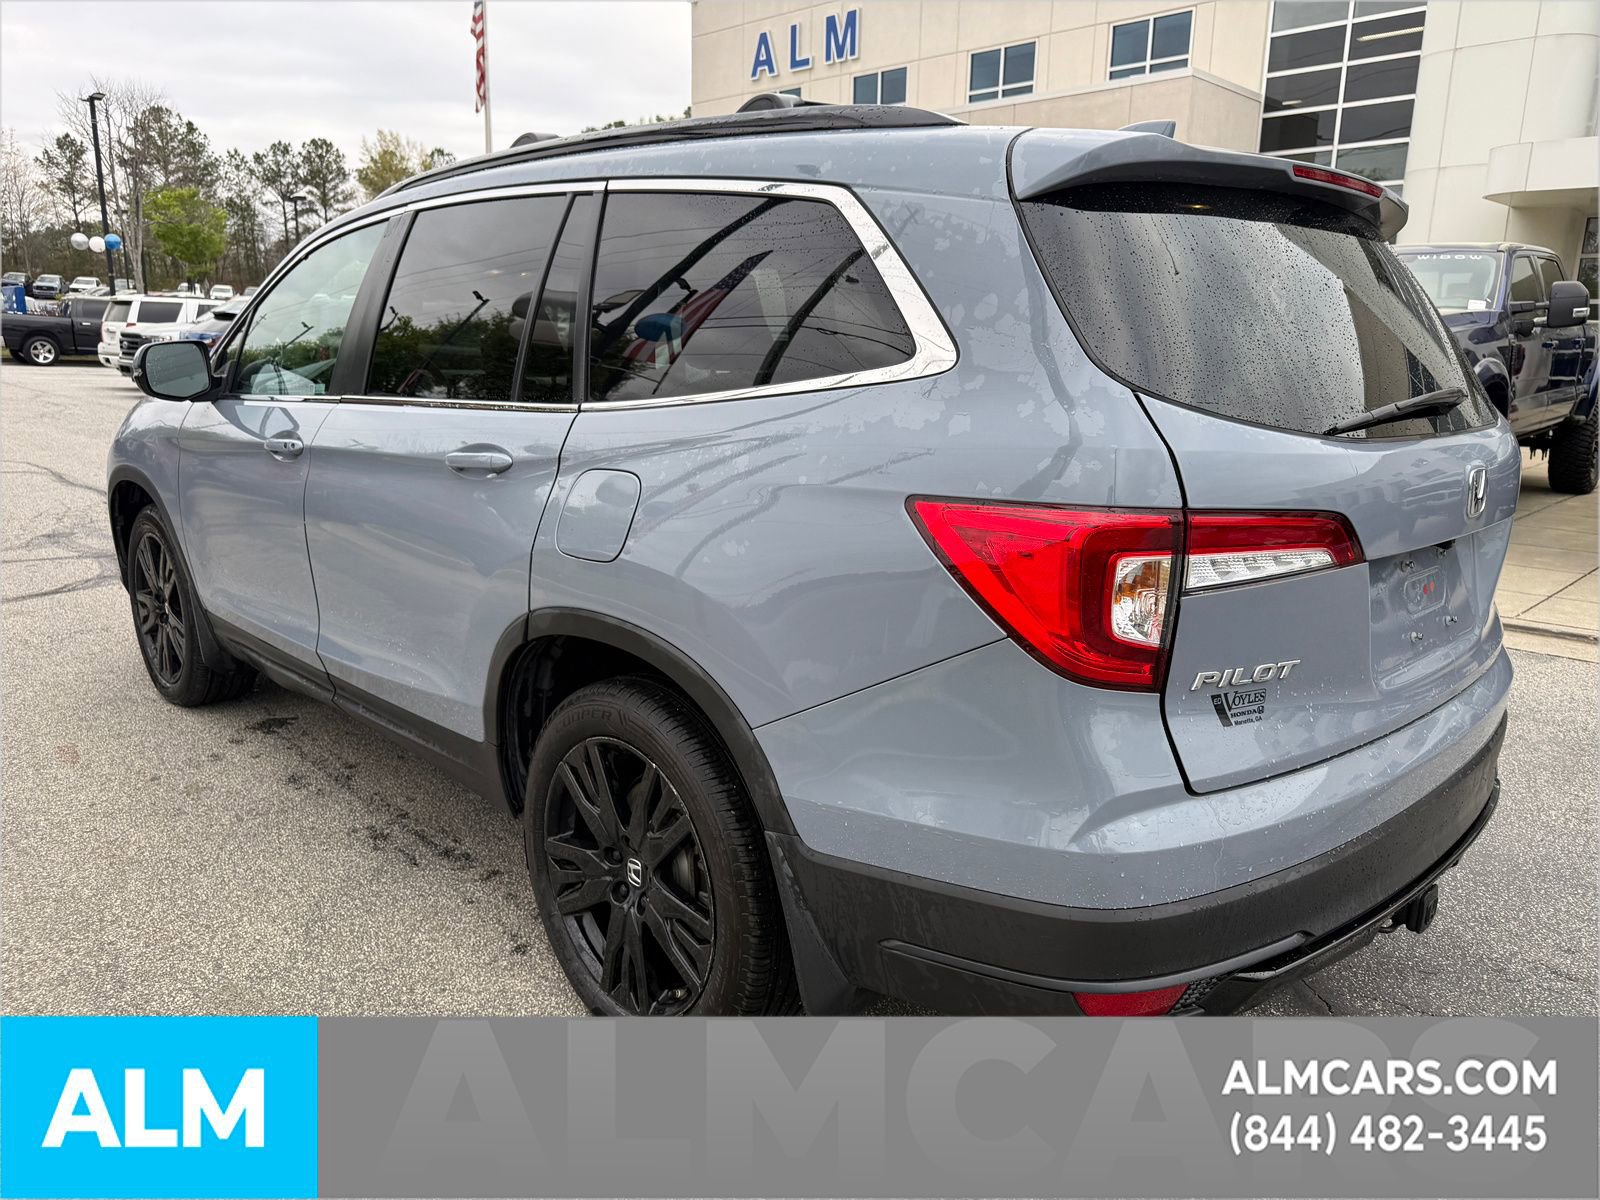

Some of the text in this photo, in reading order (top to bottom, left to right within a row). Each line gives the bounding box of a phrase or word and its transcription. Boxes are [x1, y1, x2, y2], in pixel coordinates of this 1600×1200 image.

[750, 8, 862, 81] ALM
[1190, 659, 1300, 691] PILOT
[1223, 690, 1265, 712] VOYLES
[1230, 708, 1258, 719] HONDA
